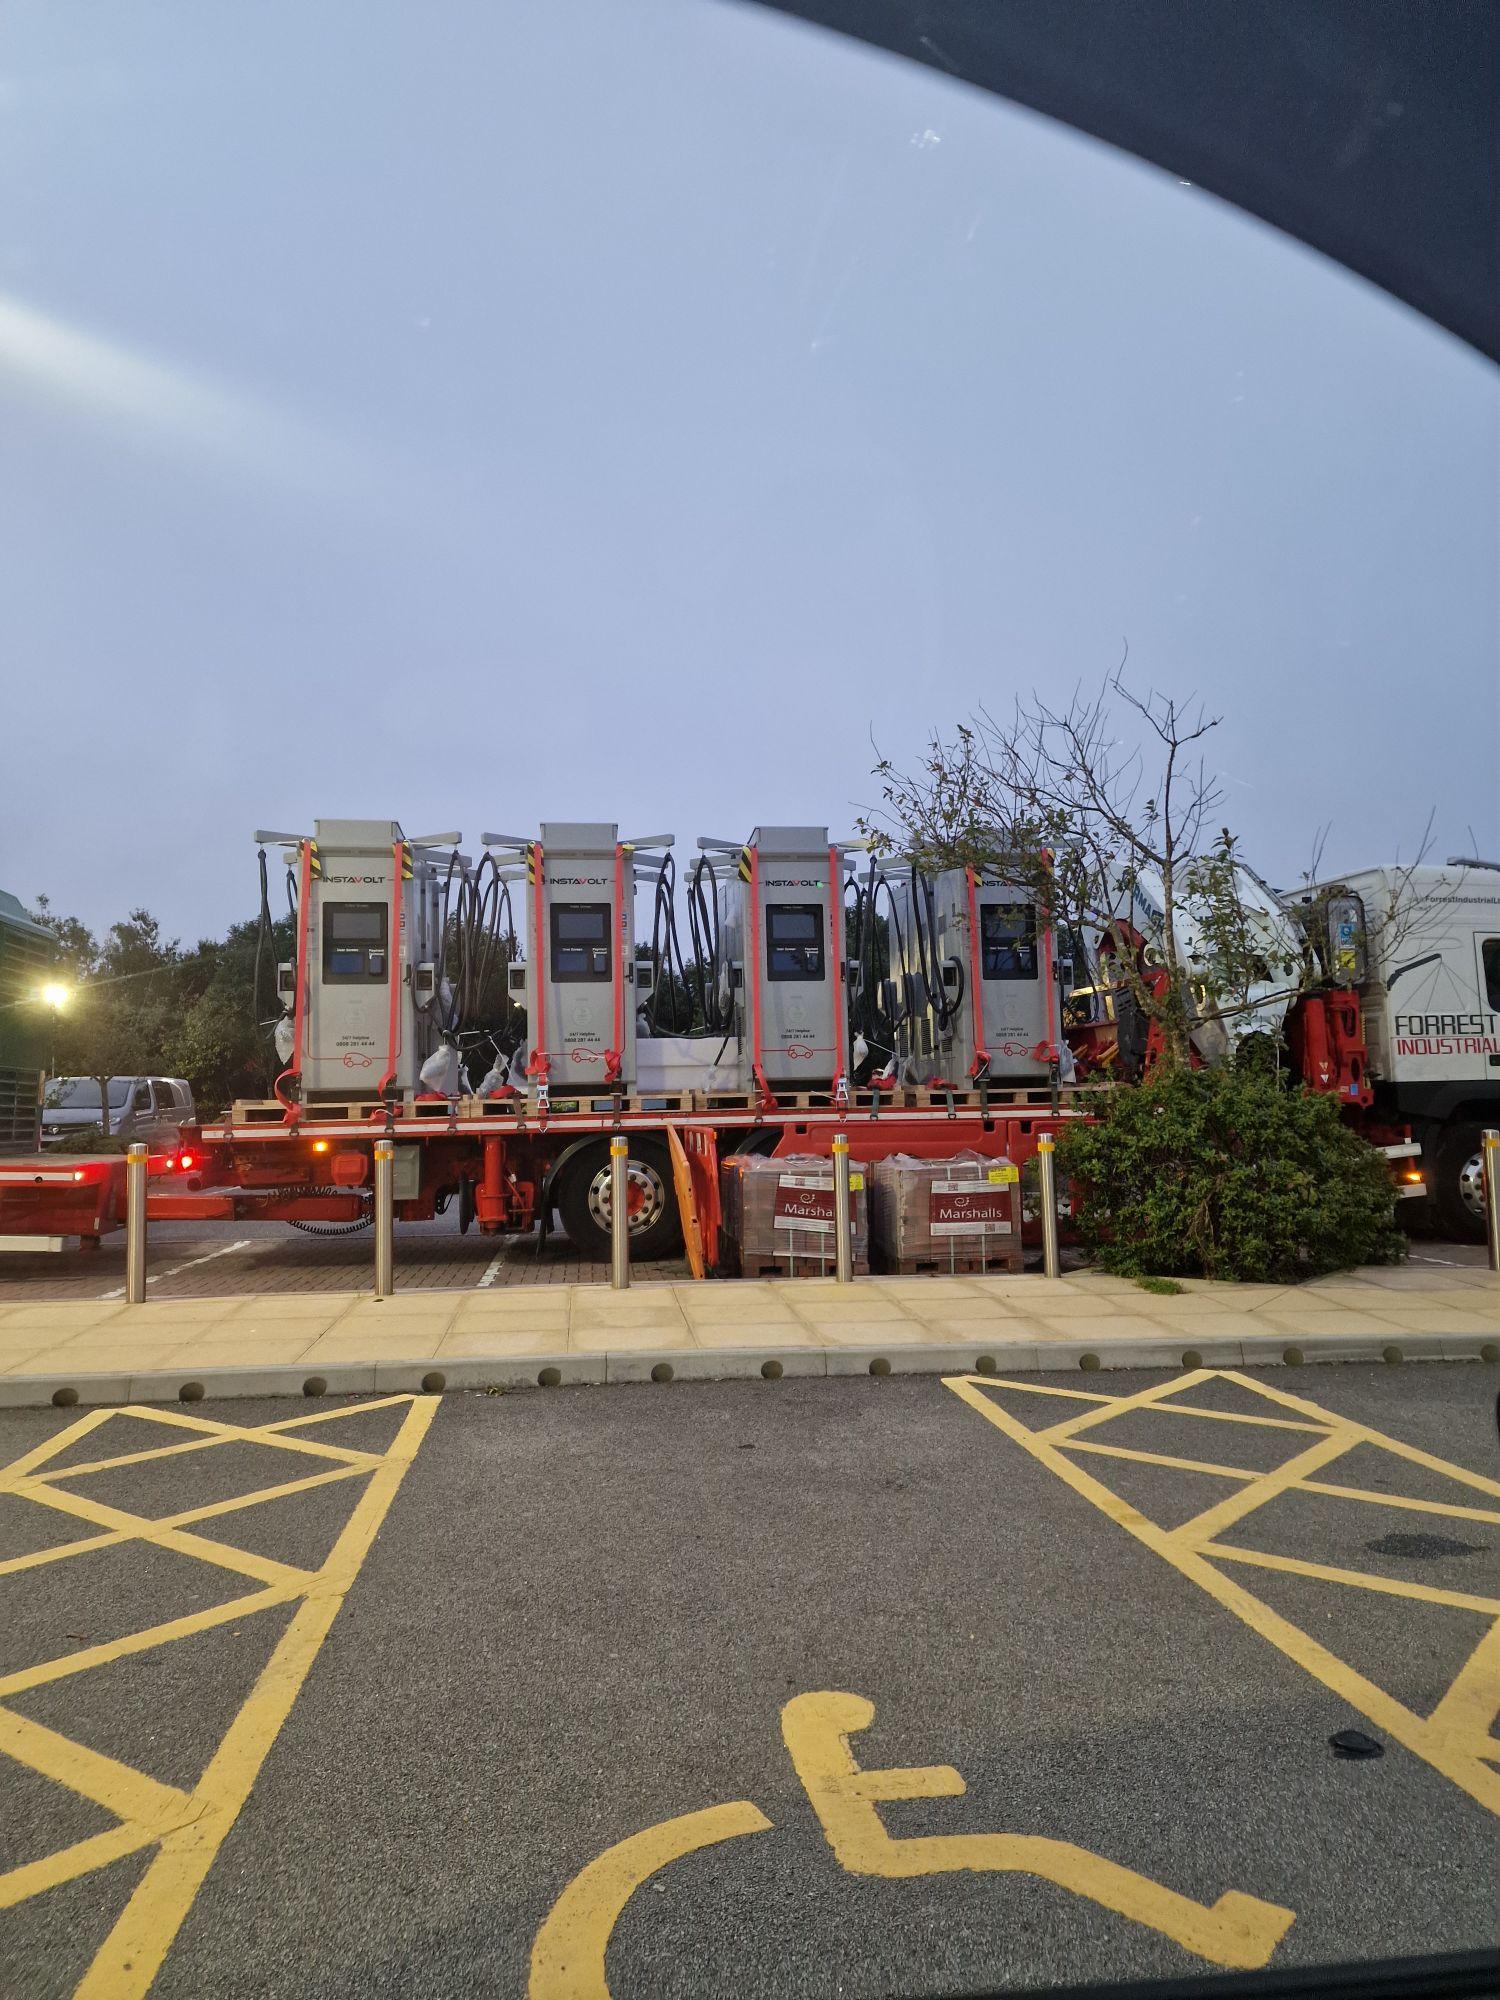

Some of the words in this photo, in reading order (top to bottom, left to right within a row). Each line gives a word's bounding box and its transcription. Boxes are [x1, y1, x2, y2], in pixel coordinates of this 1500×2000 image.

[323, 876, 385, 884] INSTAVOLT
[1395, 1014, 1498, 1036] FORREST
[1397, 1037, 1500, 1056] INDUSTRIAL
[784, 1203, 834, 1218] Marsha
[940, 1207, 1002, 1219] Marshalls
